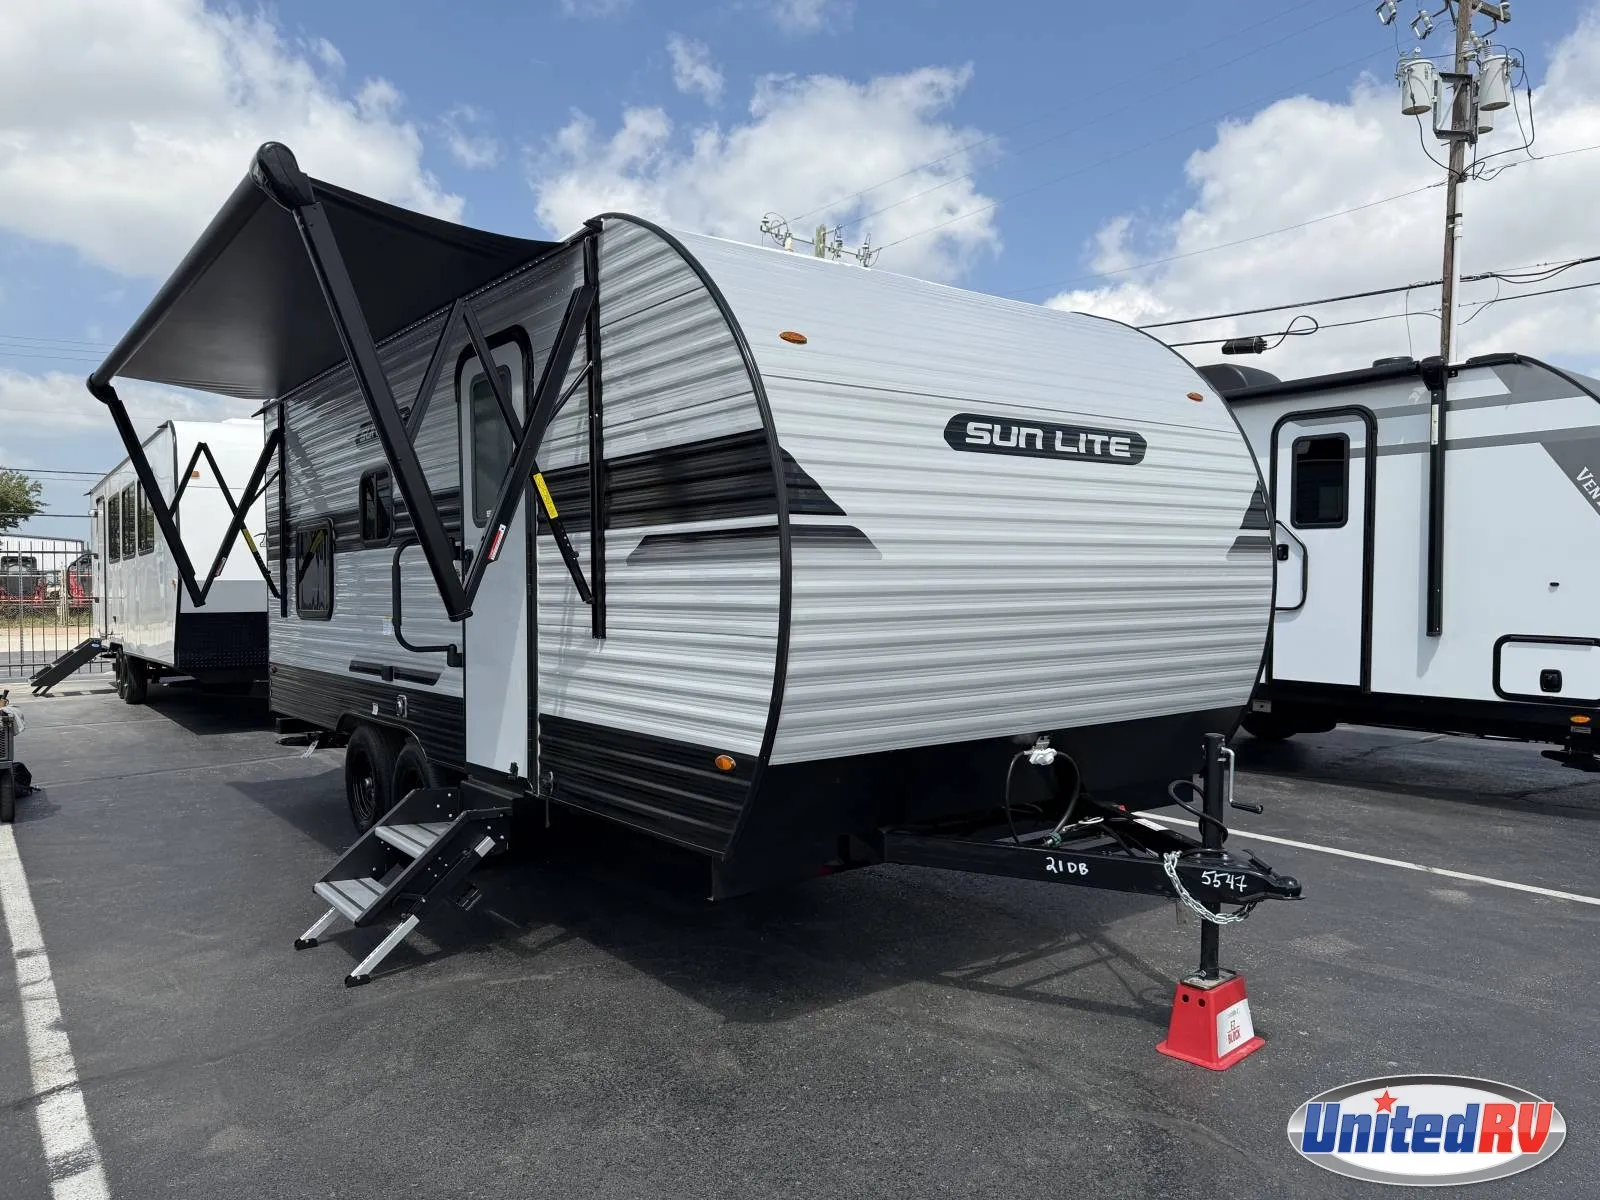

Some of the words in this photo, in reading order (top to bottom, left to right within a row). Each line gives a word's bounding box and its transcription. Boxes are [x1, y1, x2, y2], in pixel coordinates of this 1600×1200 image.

[965, 421, 1043, 449] SUN
[1055, 430, 1131, 457] LITE
[1576, 466, 1600, 506] VEN
[1201, 871, 1248, 892] 5547
